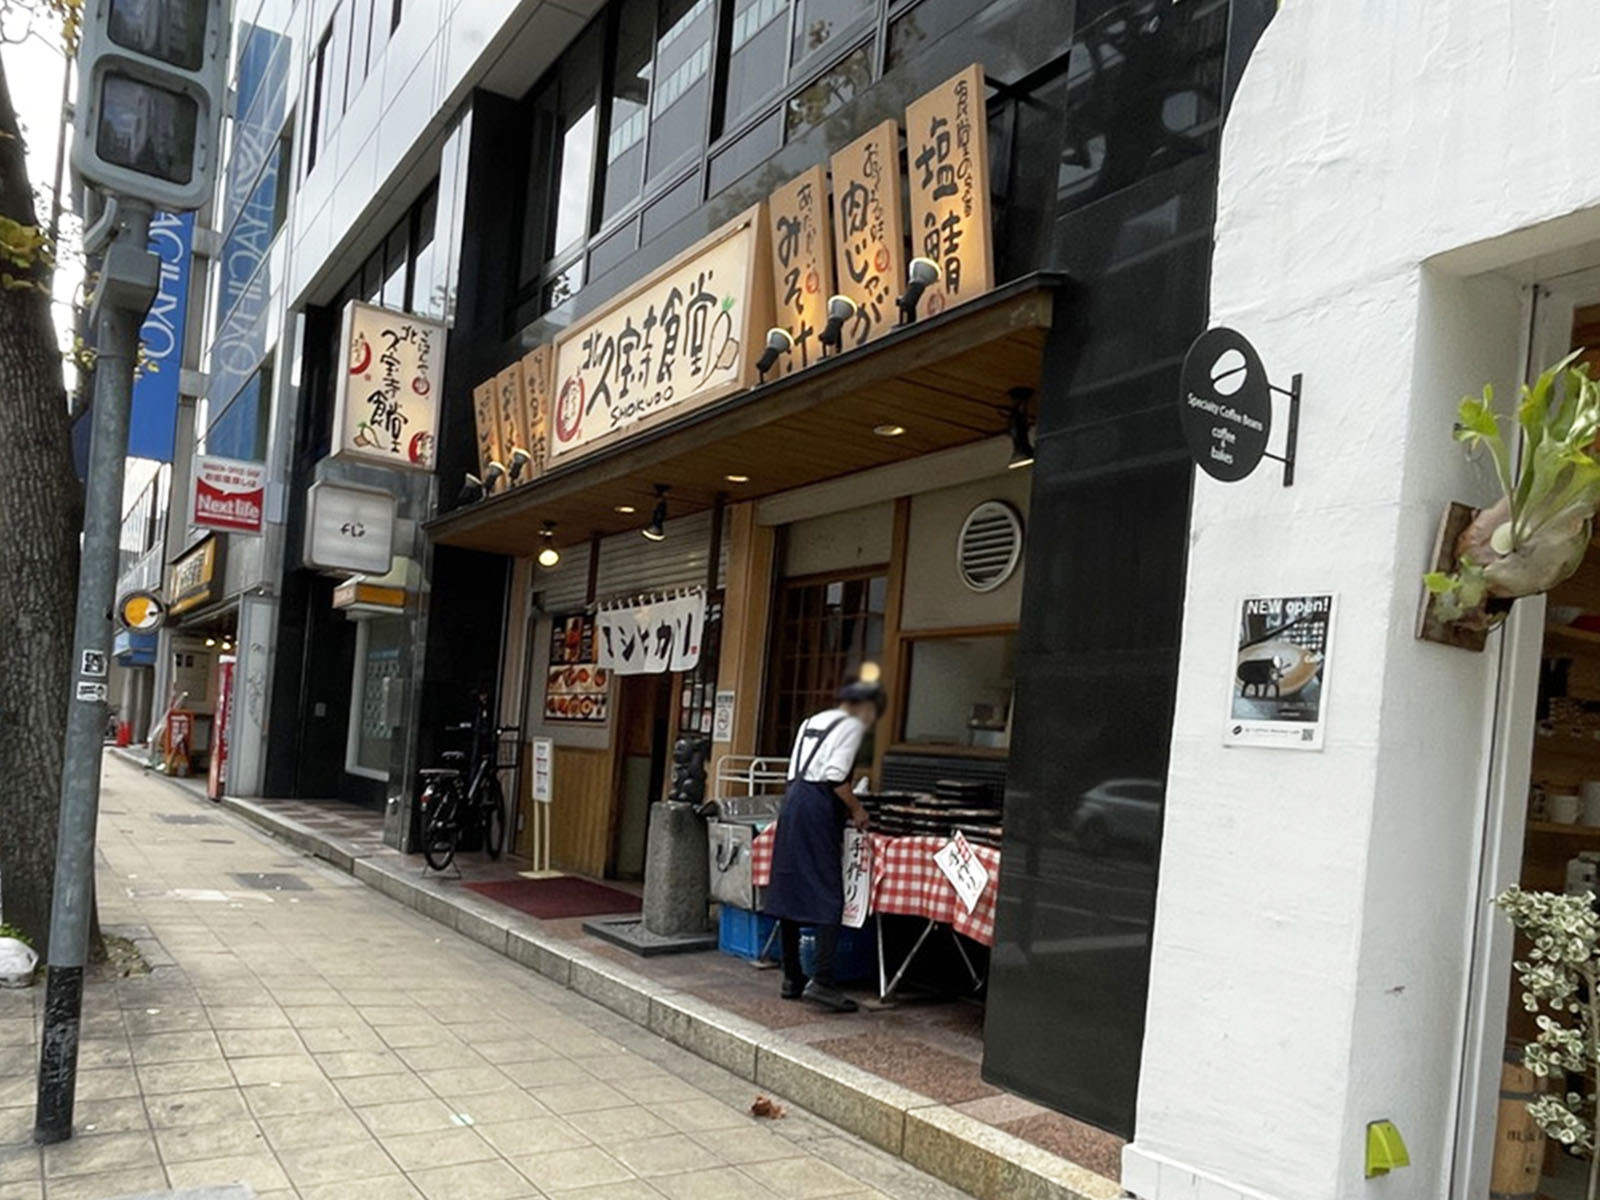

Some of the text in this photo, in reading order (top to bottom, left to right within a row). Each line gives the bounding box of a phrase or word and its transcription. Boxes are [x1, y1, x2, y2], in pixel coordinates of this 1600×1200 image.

[840, 179, 890, 345] 肉じゃが
[777, 214, 814, 374] みそ汁
[610, 385, 675, 428] SHOKUDO
[1219, 405, 1242, 424] Coffee
[1242, 414, 1264, 432] Beans
[1211, 427, 1236, 444] coffee
[198, 494, 233, 512] Next
[1247, 597, 1329, 617] NEW open!
[846, 836, 864, 903] 手作り
